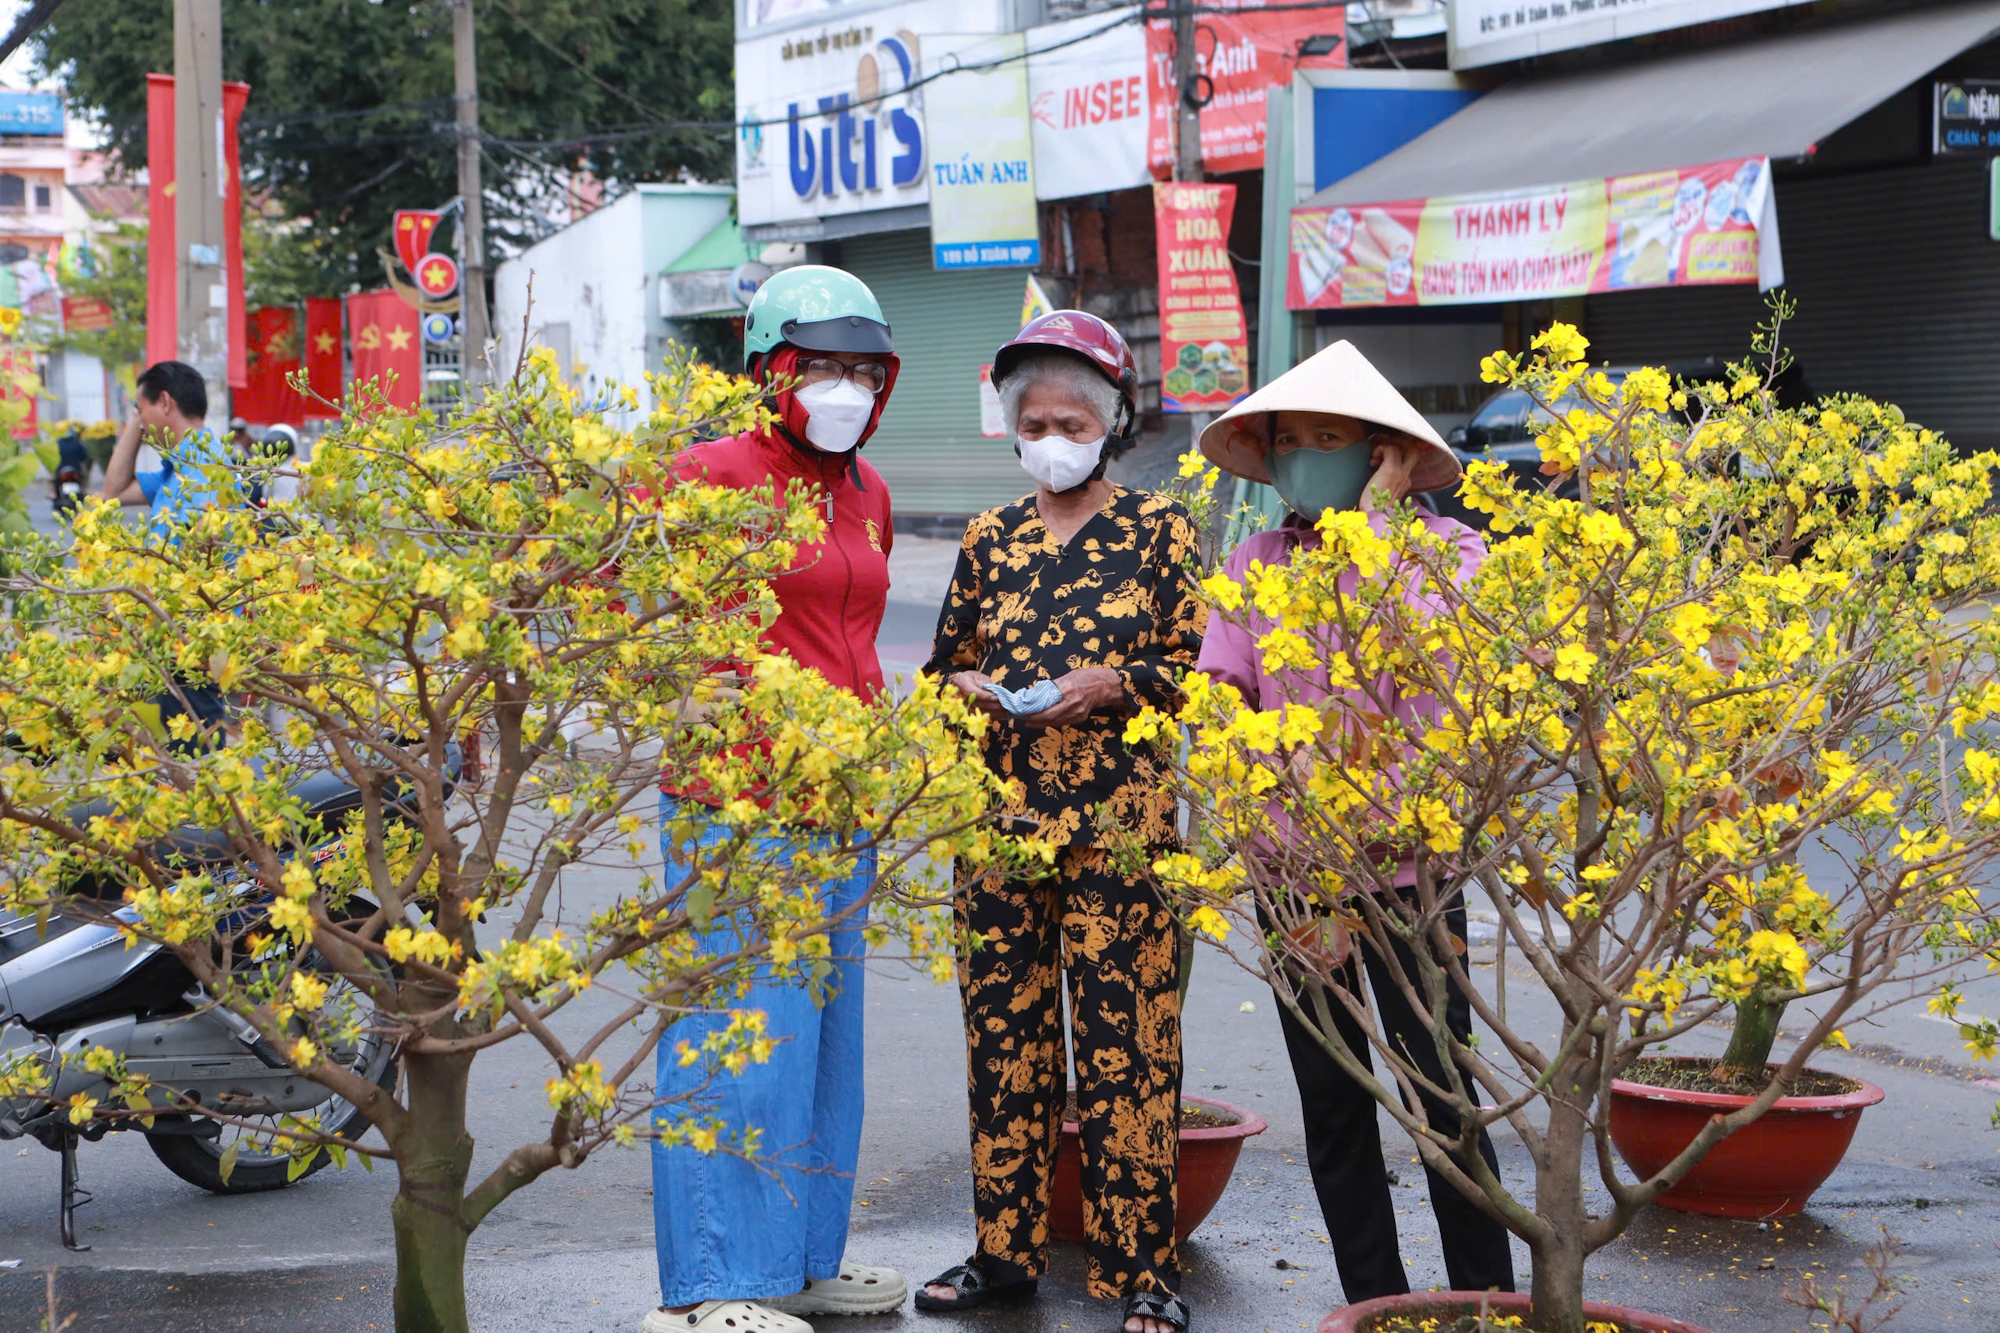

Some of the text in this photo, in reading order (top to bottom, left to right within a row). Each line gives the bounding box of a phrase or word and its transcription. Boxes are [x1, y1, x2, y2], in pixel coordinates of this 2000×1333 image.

[1063, 75, 1142, 129] INSEE
[933, 150, 1029, 187] TUẤN ANH
[1175, 216, 1223, 242] HOA
[1453, 201, 1531, 240] THANH
[1538, 187, 1568, 231] LÝ
[1168, 243, 1231, 273] XUÂN
[1490, 256, 1519, 292] KHO
